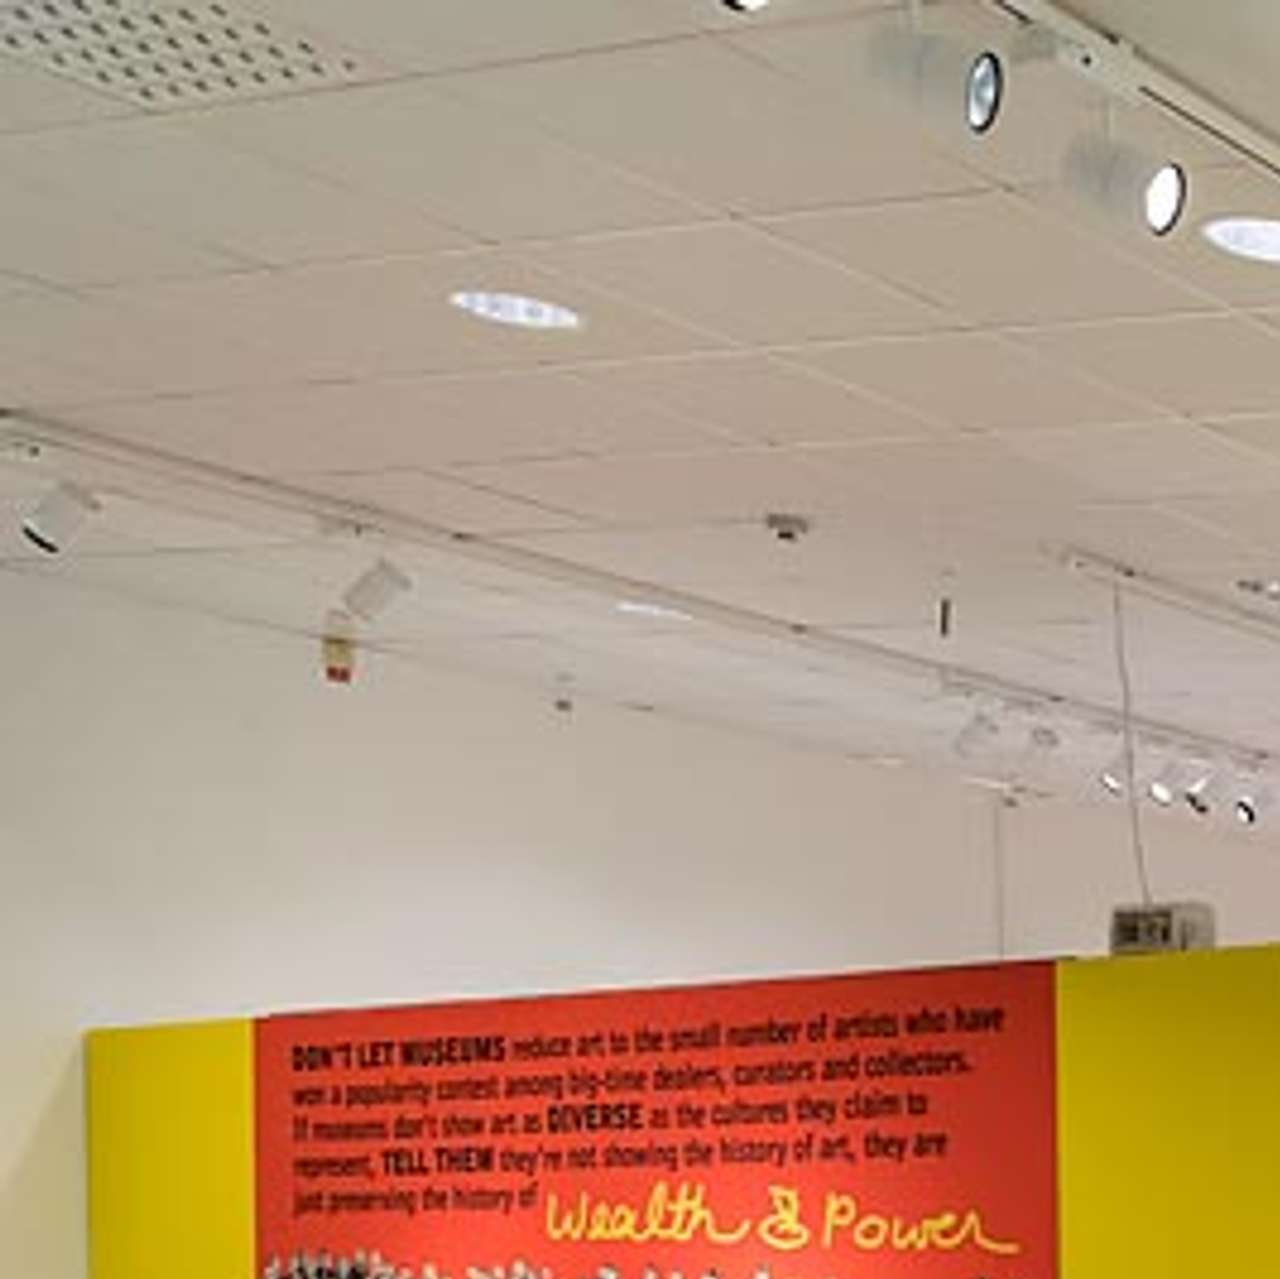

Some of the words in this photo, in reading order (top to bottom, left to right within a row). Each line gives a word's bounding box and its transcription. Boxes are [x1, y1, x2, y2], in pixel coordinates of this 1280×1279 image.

[292, 1043, 351, 1071] DON'T
[357, 1041, 395, 1068] LET
[401, 1036, 505, 1067] MUSEUMS
[807, 1013, 827, 1042] of
[906, 1007, 947, 1034] who
[953, 1006, 1005, 1033] have
[821, 1053, 859, 1080] and
[547, 1103, 644, 1134] DIVERSE
[907, 1090, 928, 1115] to
[383, 1148, 430, 1175] TELL
[433, 1147, 495, 1173] THEM
[547, 1180, 752, 1242] Wealth
[823, 1191, 1021, 1254] Power
